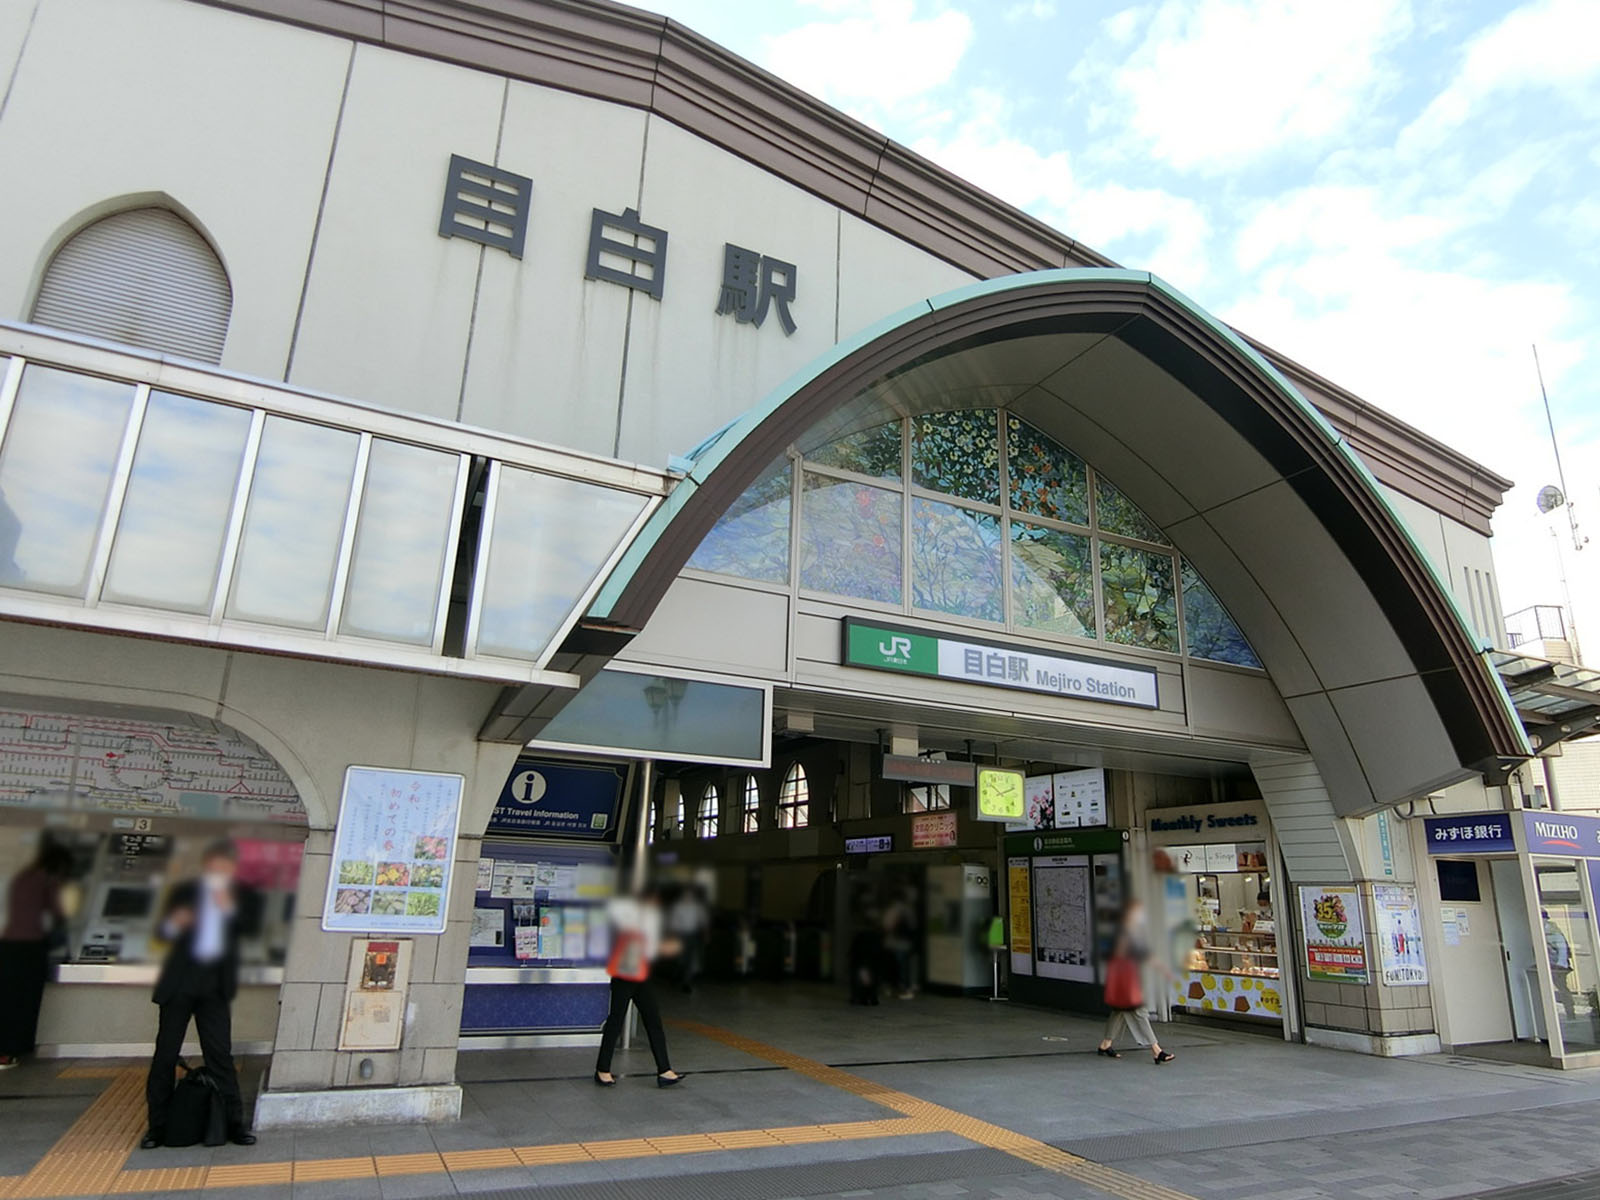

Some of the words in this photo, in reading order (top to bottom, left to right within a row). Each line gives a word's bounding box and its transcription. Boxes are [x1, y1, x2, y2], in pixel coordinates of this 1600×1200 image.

[438, 153, 798, 338] 目白駅
[879, 636, 912, 659] JR
[964, 648, 1030, 682] 目白駅
[1036, 669, 1082, 692] Mejiro
[1086, 677, 1136, 700] Station
[507, 807, 532, 817] Travel
[533, 809, 579, 820] Information
[1151, 814, 1203, 833] Monthly
[1207, 813, 1258, 829] Sweets
[139, 819, 148, 830] 3
[914, 822, 954, 833] のクリニック
[1434, 824, 1503, 841] みずほ銀行
[1534, 821, 1579, 840] MIZUHO
